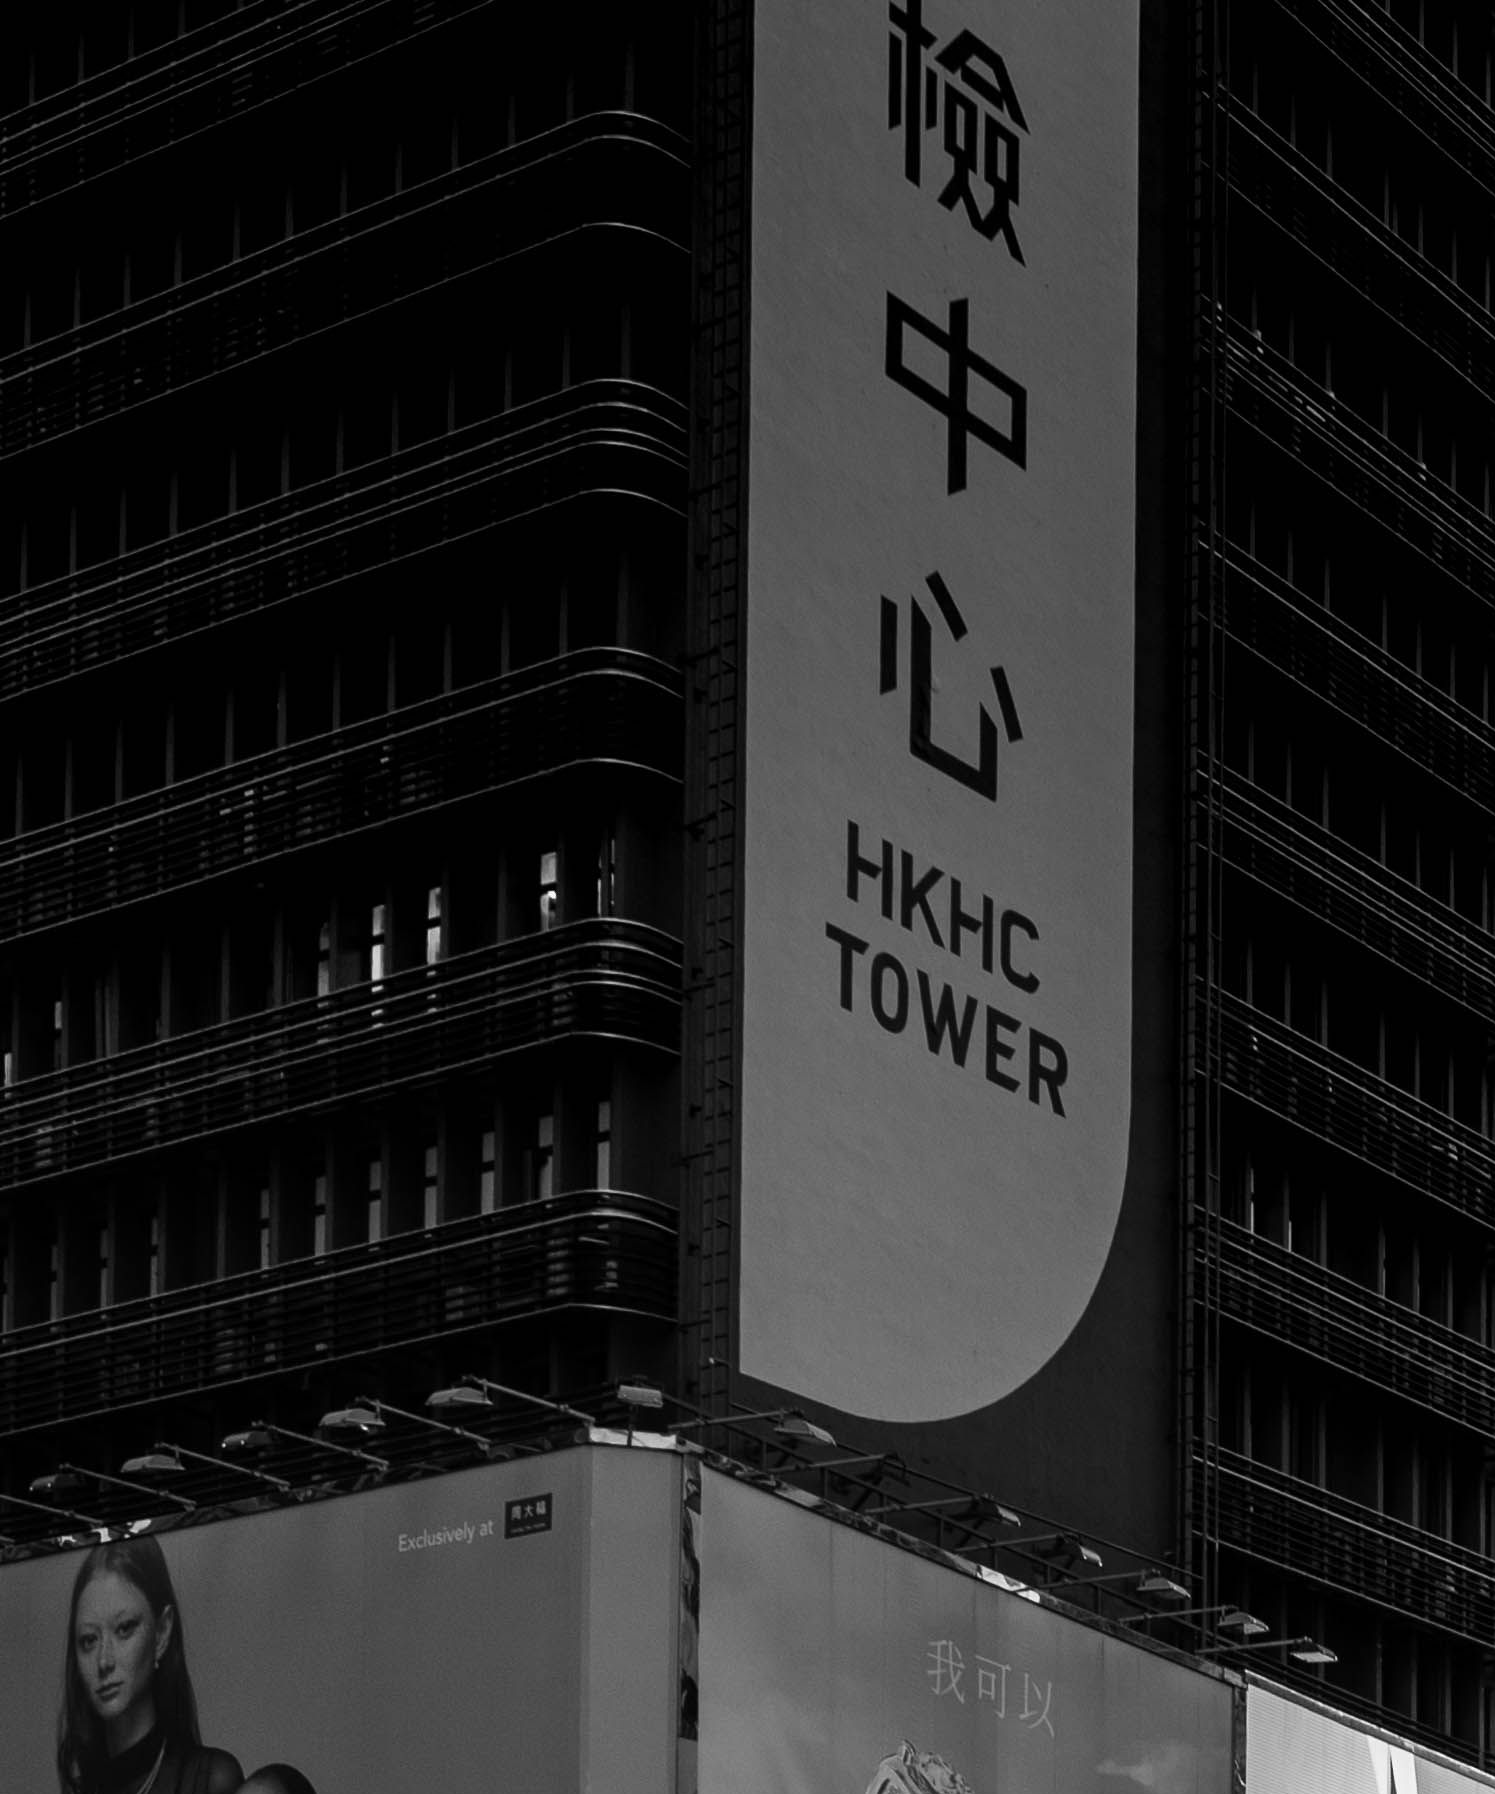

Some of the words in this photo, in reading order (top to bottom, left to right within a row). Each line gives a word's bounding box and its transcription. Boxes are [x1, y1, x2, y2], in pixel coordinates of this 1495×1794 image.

[846, 819, 1040, 994] HKHC
[825, 920, 1069, 1119] TOWER
[398, 1521, 475, 1552] Exclusively
[479, 1520, 494, 1537] at
[926, 1639, 1055, 1739] 我可以
